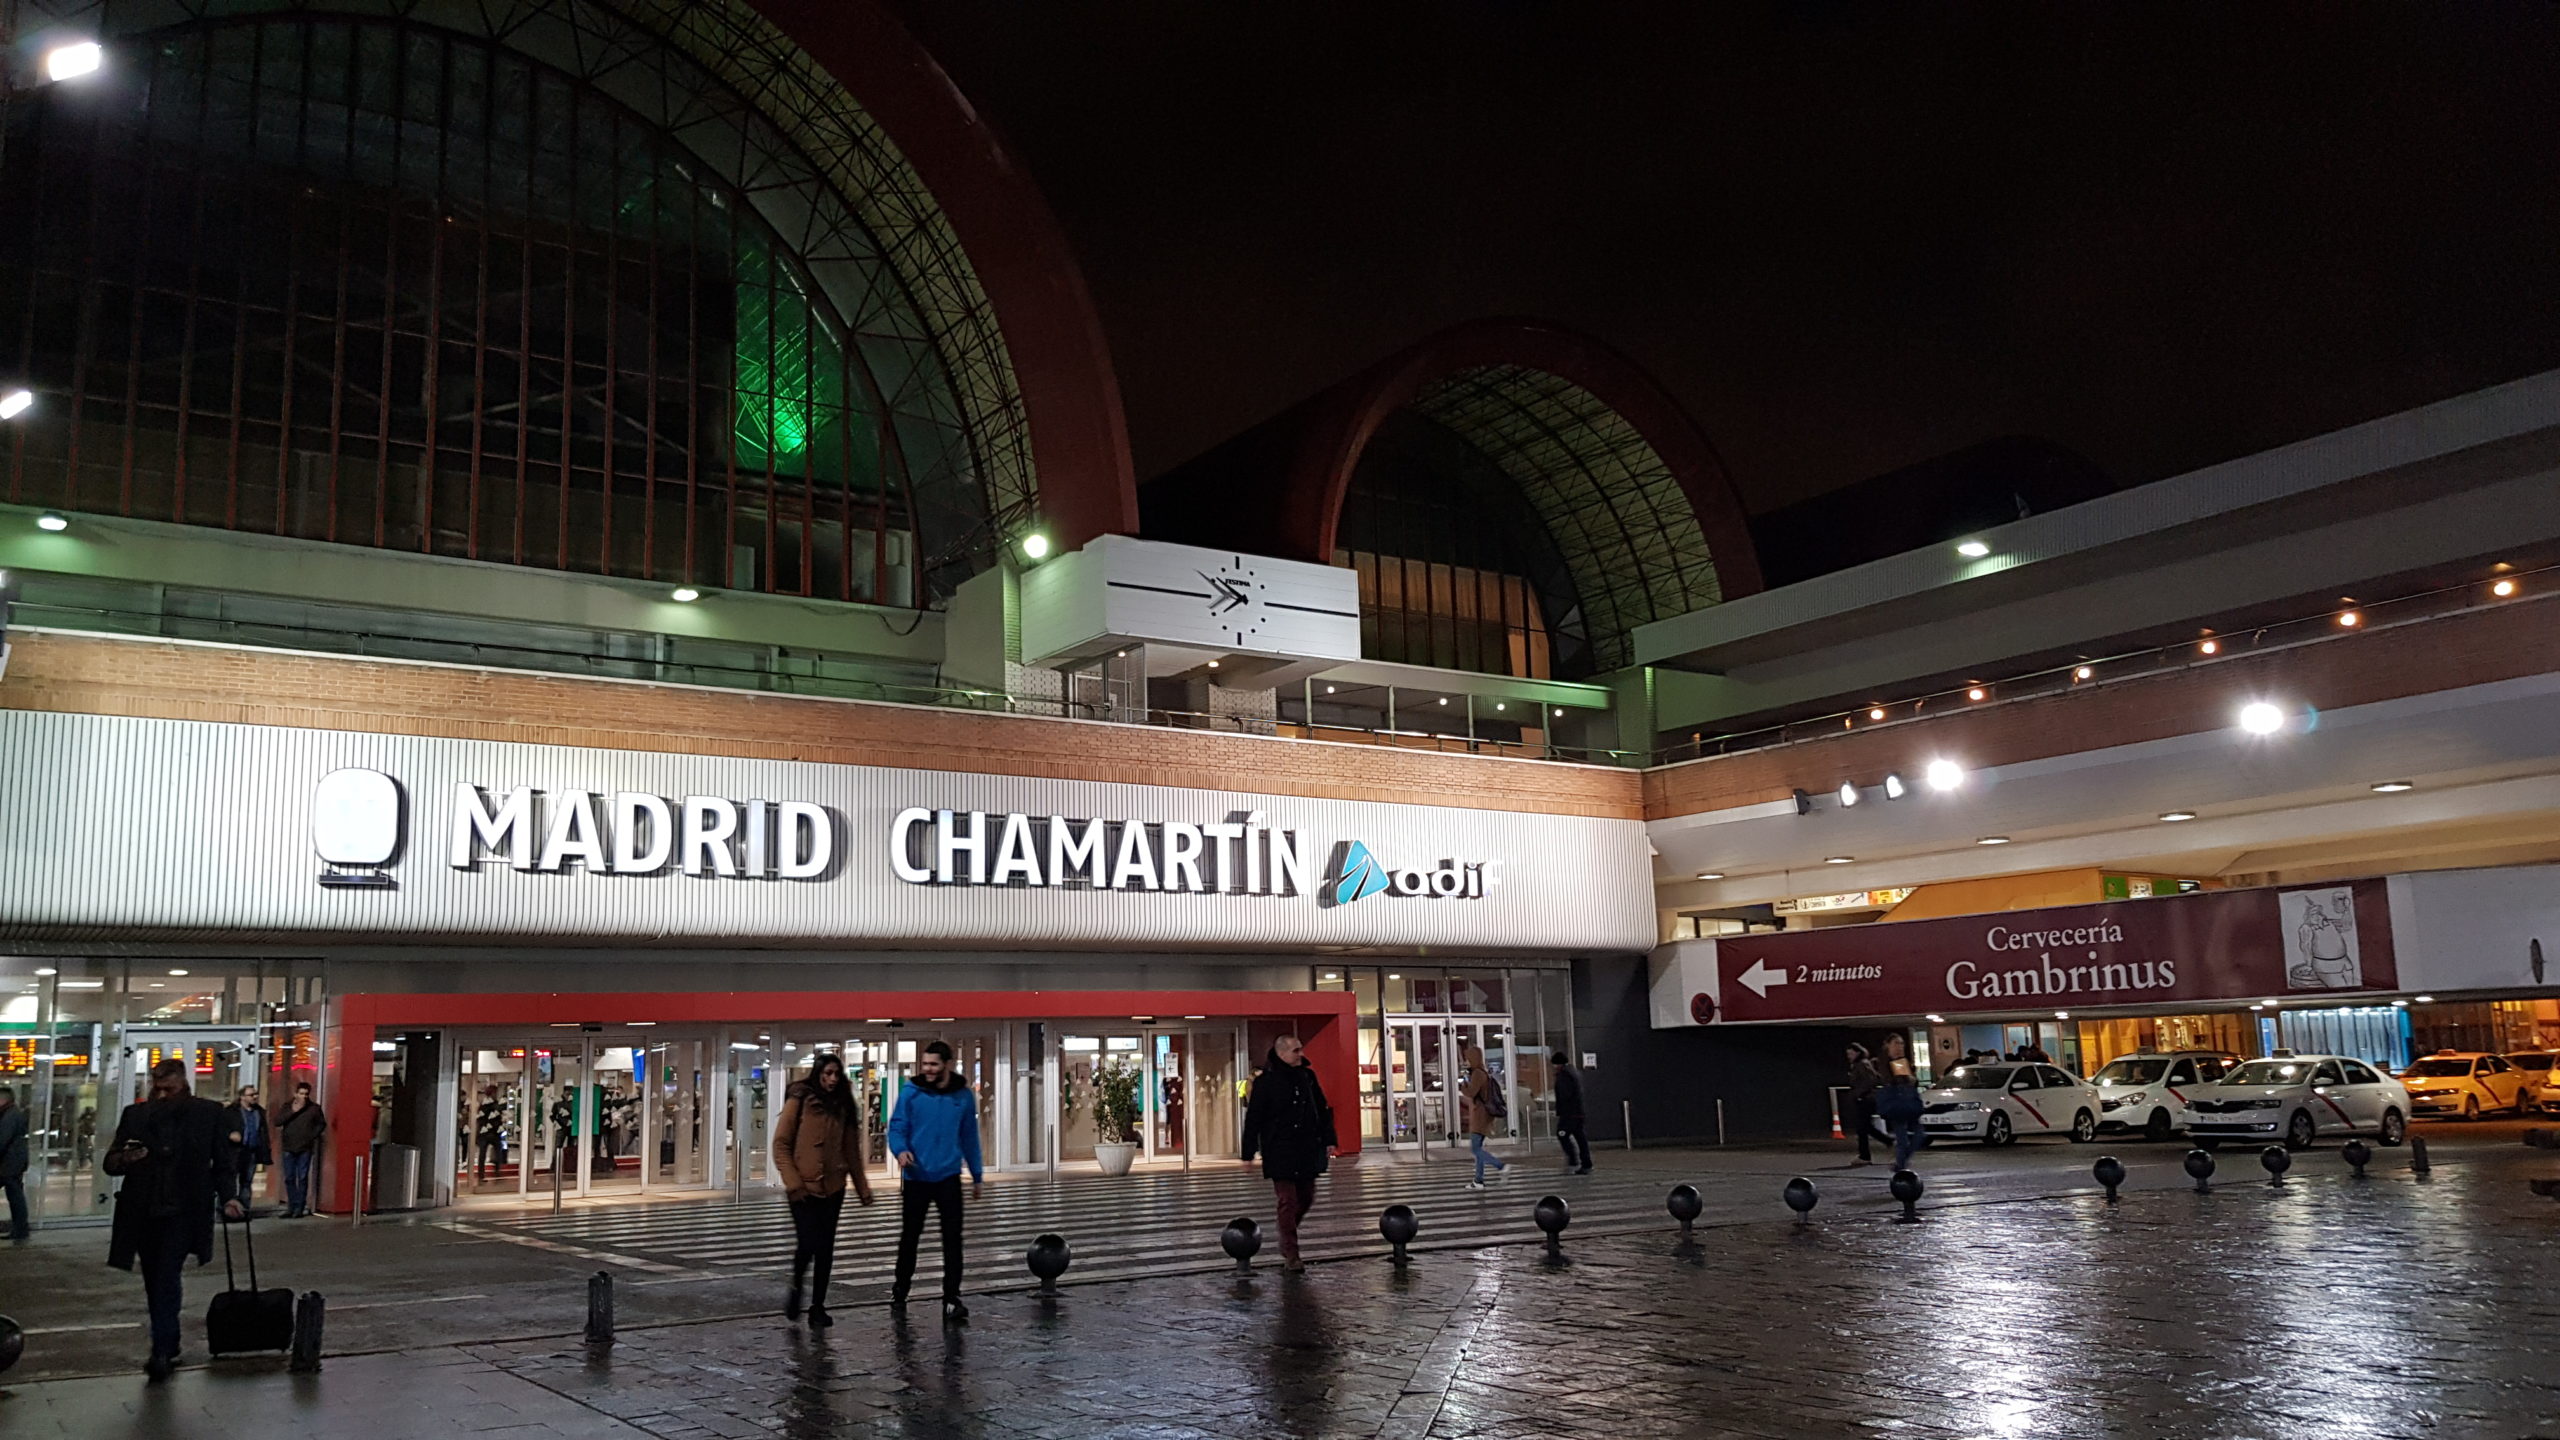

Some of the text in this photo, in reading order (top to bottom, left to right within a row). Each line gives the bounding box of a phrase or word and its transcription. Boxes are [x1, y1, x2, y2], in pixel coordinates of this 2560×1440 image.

[449, 782, 1309, 896] MADRID CHAMARTÍN
[1395, 856, 1503, 897] adif
[1986, 918, 2124, 951] Cervecería
[1795, 963, 1882, 983] 2 minutos
[1945, 951, 2176, 999] Gambrinus
